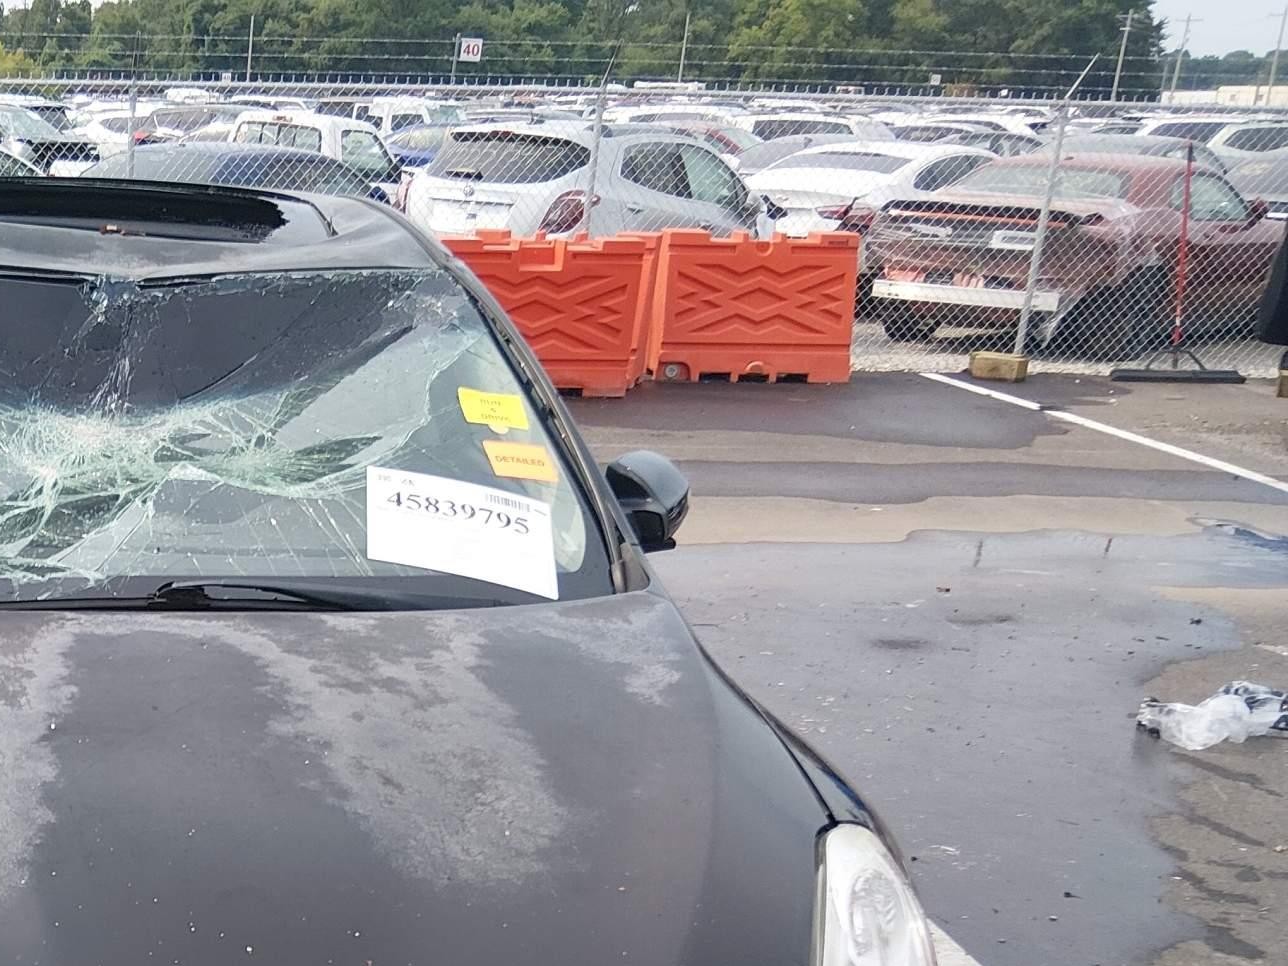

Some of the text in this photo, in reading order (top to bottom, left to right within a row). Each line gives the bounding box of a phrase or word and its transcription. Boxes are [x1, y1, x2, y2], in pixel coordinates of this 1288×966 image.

[463, 43, 480, 57] 40
[494, 455, 545, 467] DETAILED
[386, 491, 530, 535] 45839795
